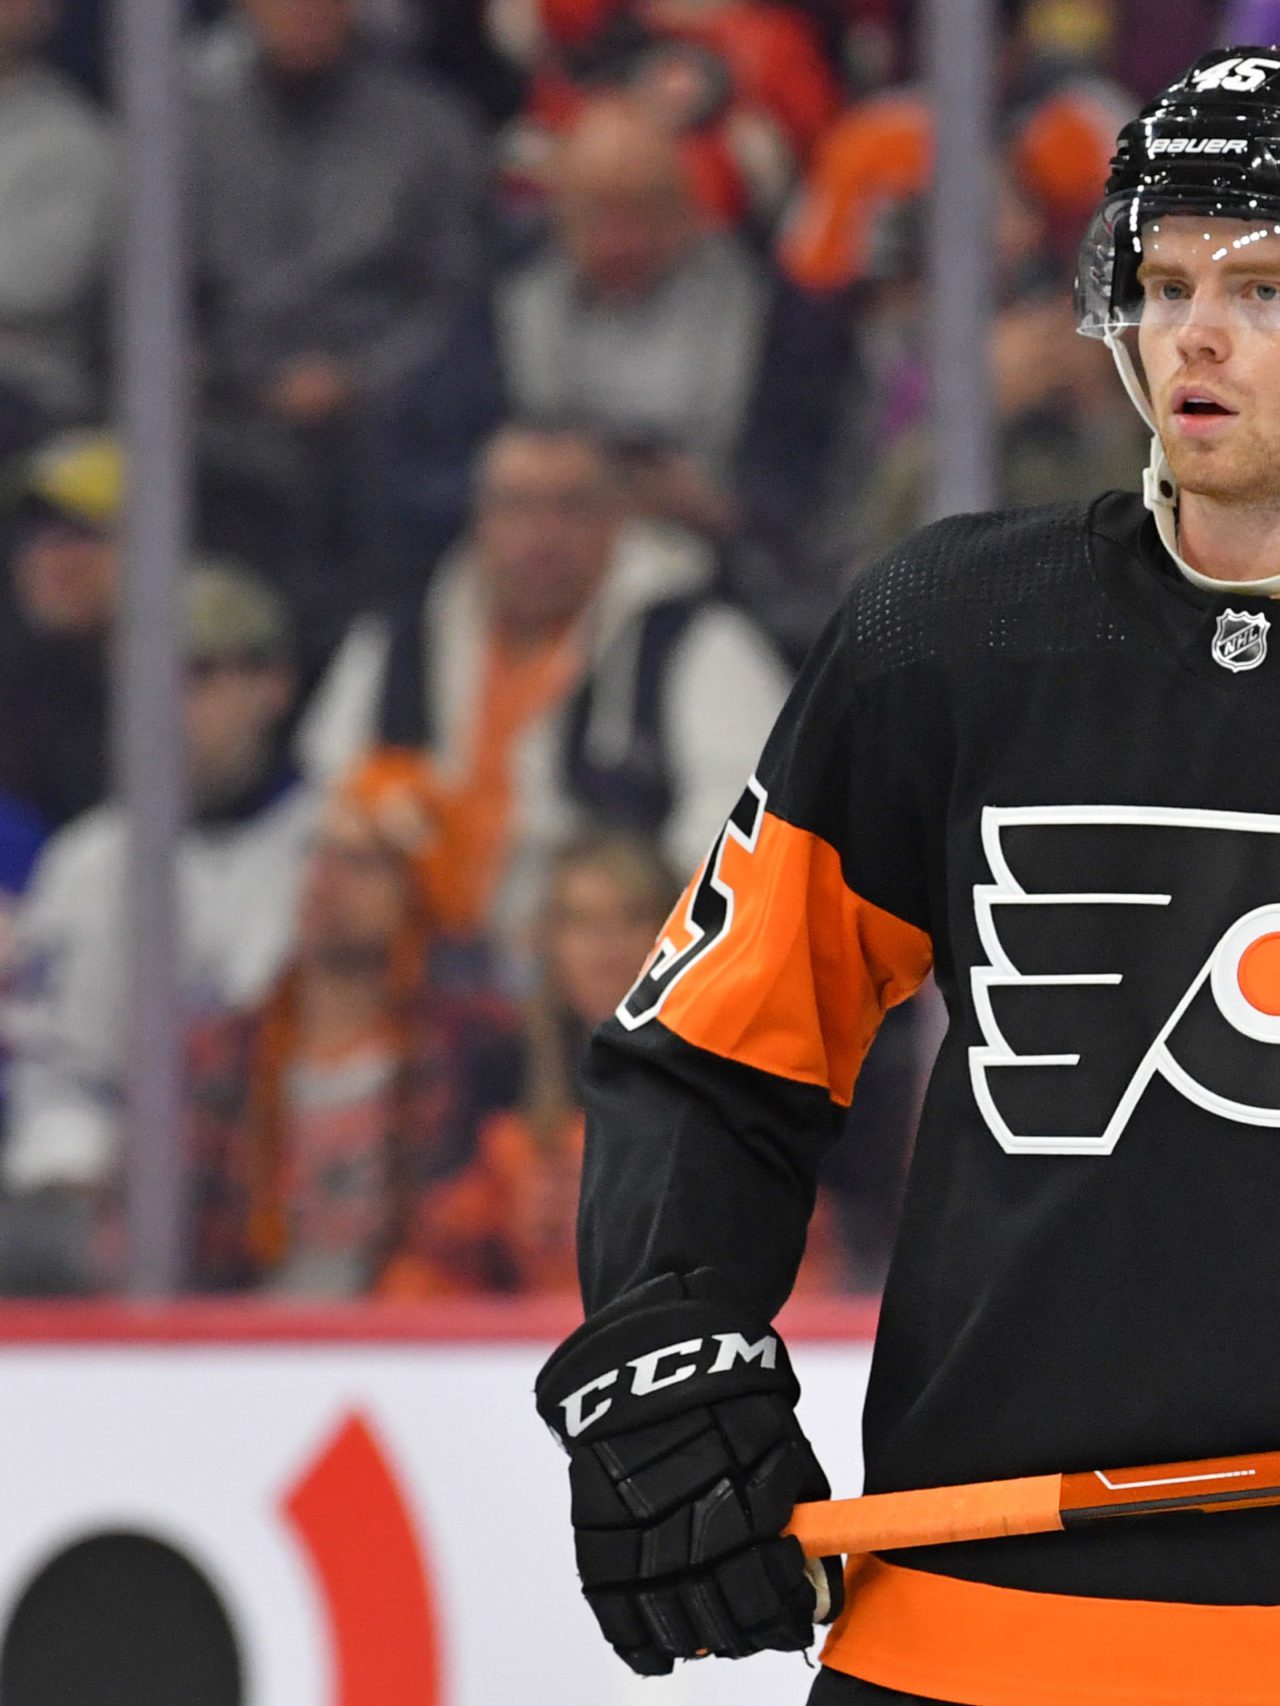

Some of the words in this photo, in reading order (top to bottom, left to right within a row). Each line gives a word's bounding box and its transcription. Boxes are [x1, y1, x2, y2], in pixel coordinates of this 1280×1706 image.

[1150, 138, 1248, 153] BAUER
[1223, 627, 1259, 657] NHL
[557, 1332, 778, 1438] CCM
